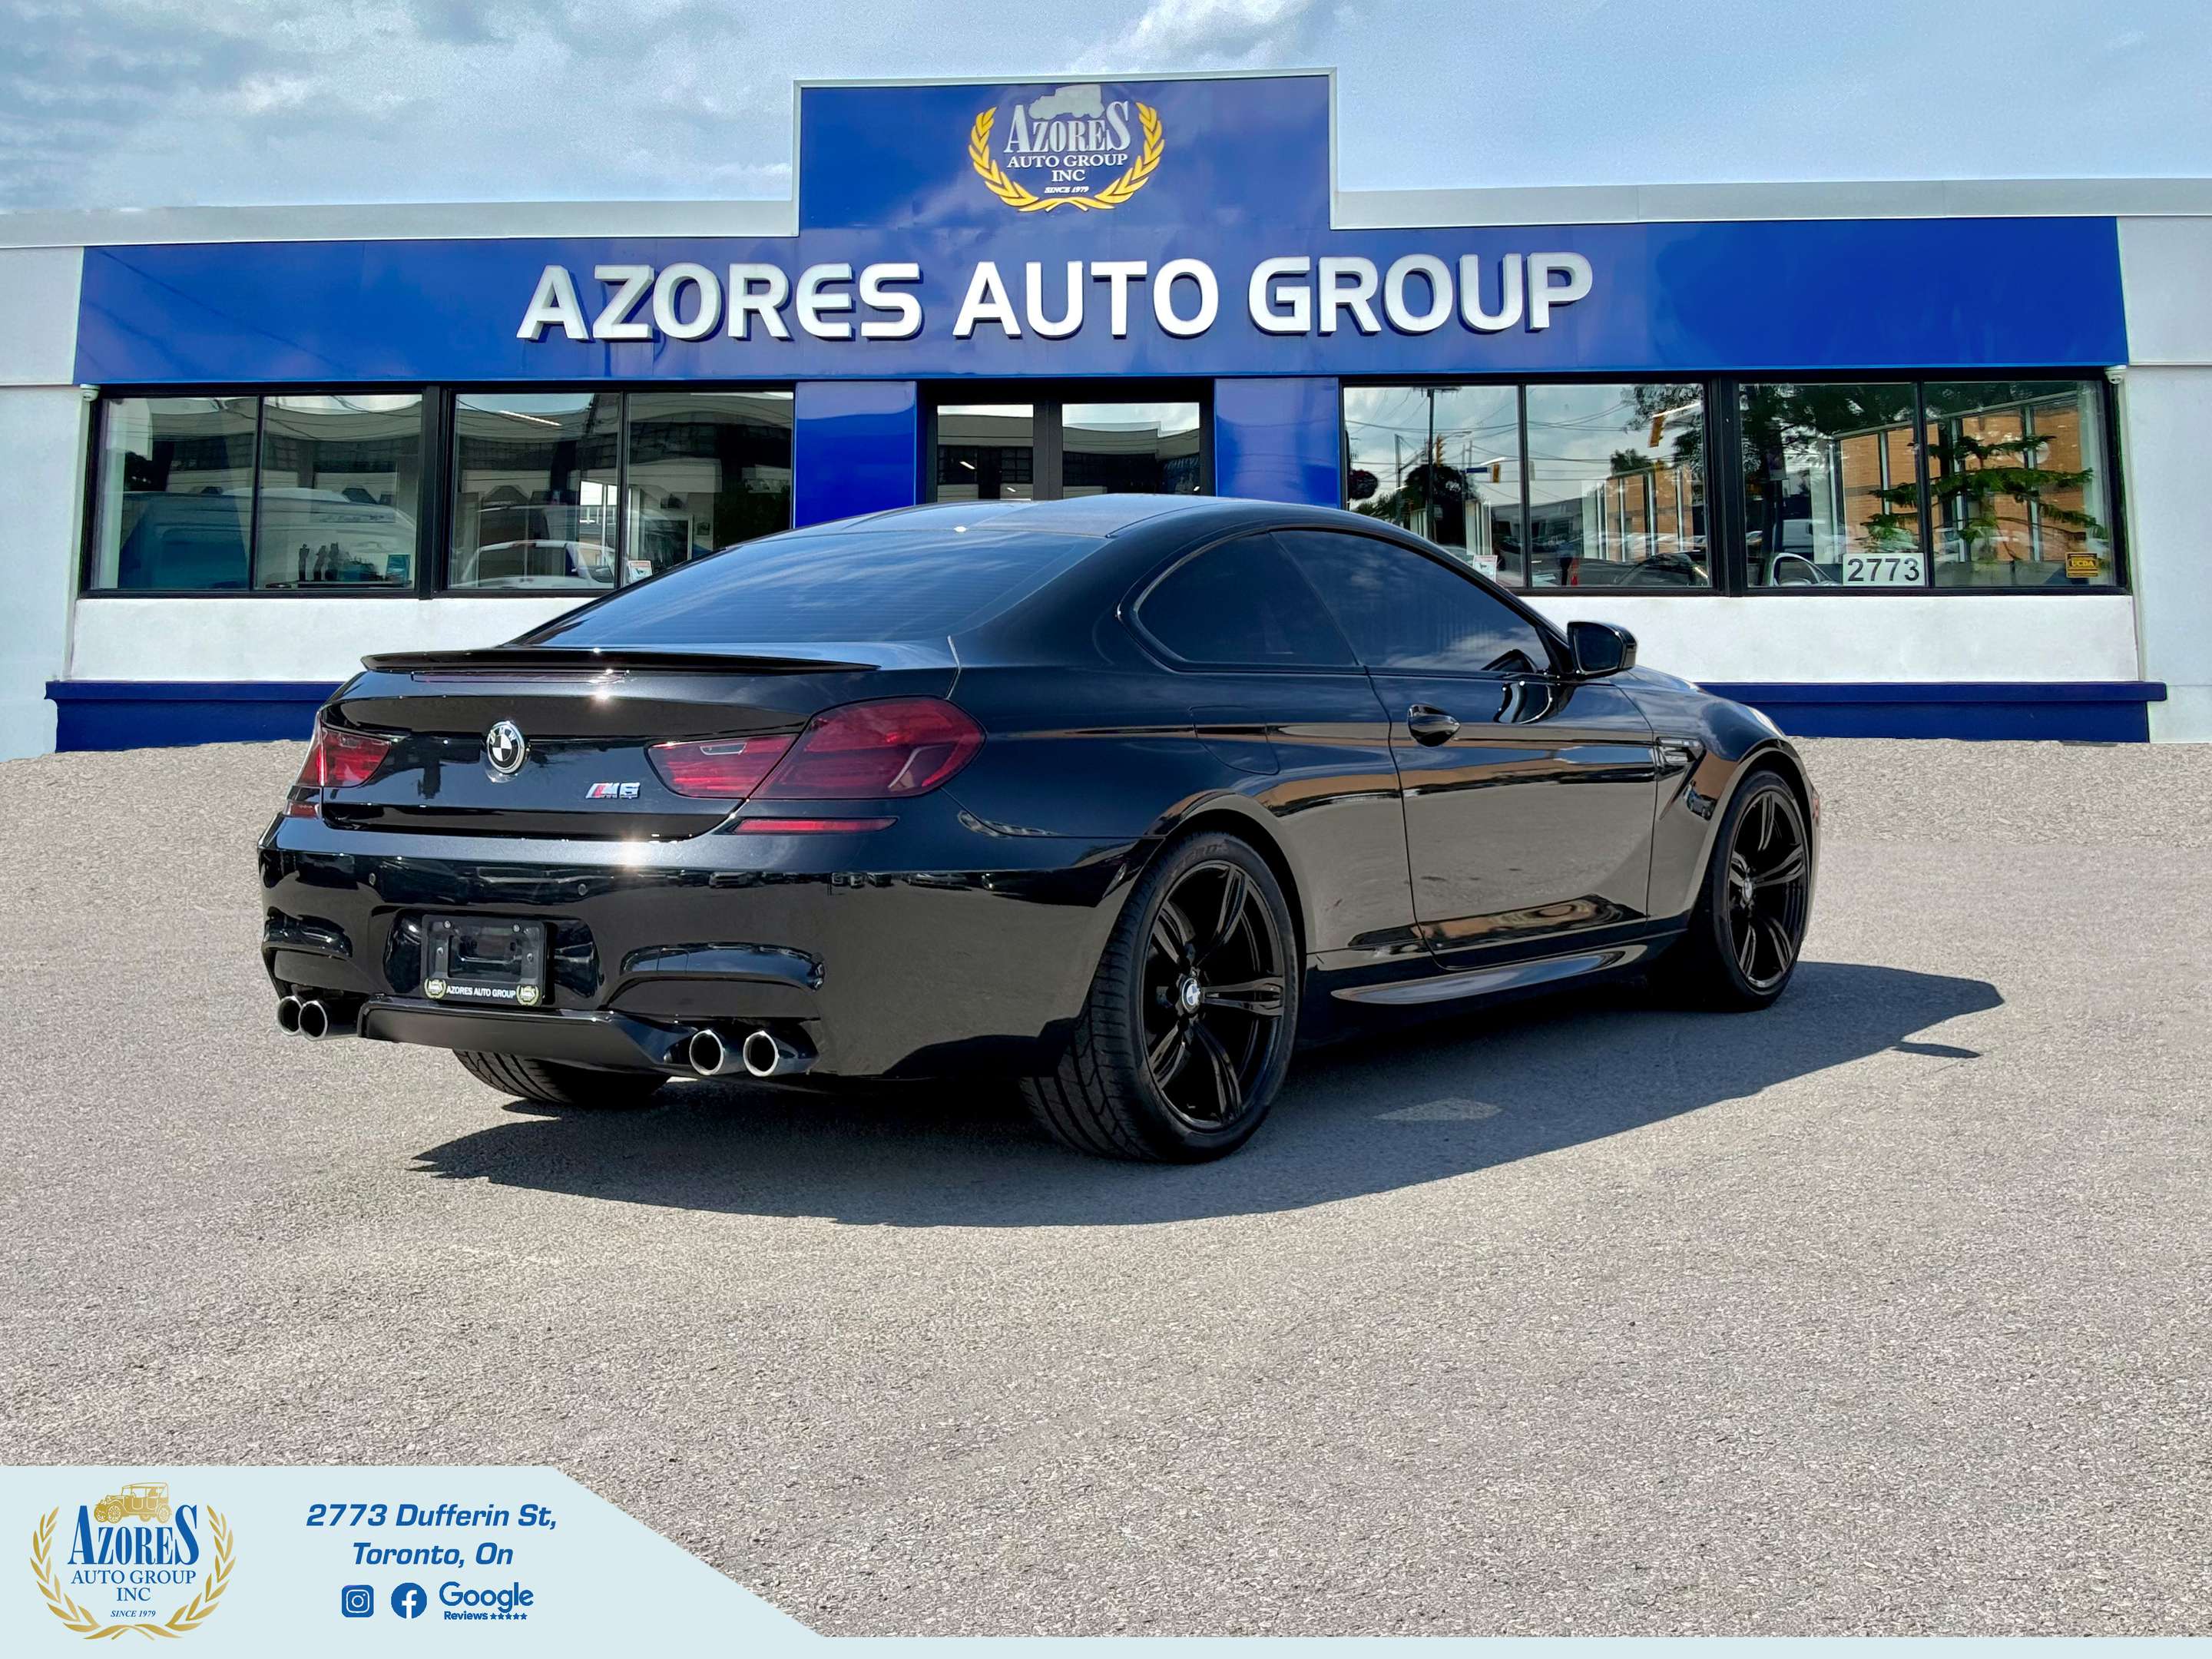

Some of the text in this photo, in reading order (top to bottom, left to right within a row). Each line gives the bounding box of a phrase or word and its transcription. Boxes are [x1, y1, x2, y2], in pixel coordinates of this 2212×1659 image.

[1003, 101, 1131, 153] AZORES
[1007, 154, 1128, 168] AUTO GROUP
[1051, 169, 1086, 182] INC
[516, 252, 1594, 341] AZORES AUTO GROUP
[1847, 558, 1919, 581] 2773
[445, 985, 473, 995] AZORES
[474, 987, 492, 997] AUTO
[492, 988, 516, 998] GROUP
